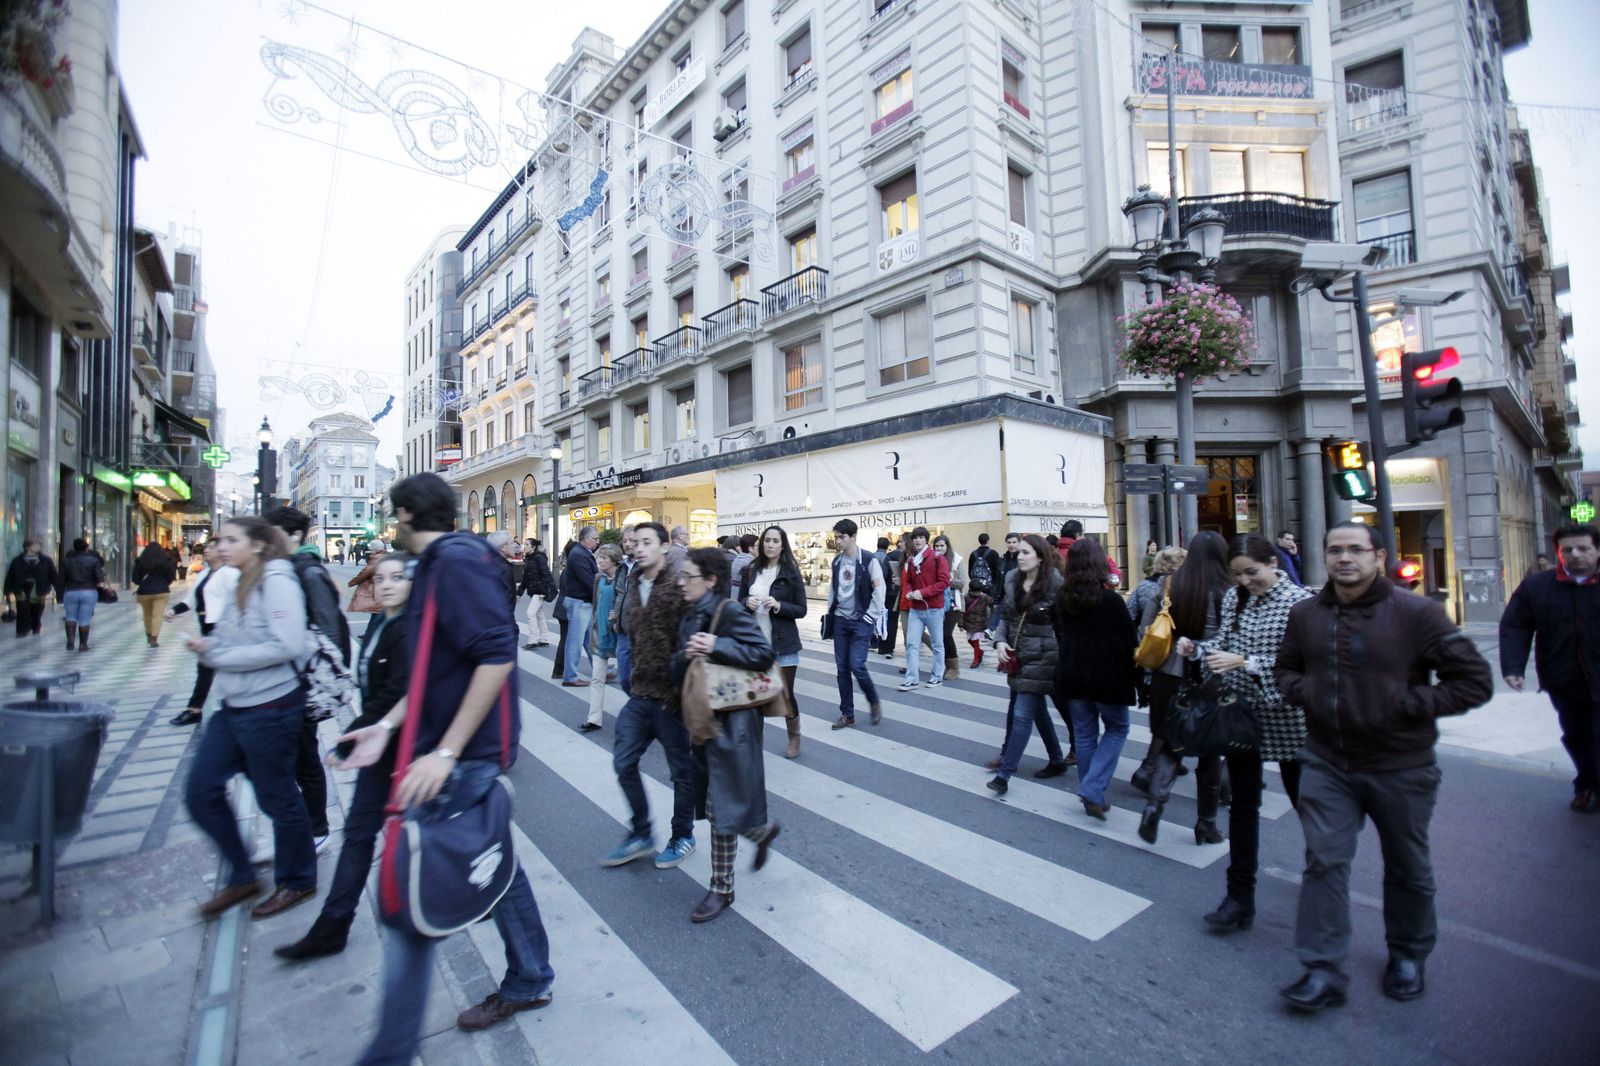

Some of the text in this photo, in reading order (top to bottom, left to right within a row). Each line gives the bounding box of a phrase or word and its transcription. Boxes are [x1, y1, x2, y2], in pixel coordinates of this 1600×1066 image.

[900, 493, 937, 502] CHAUSSURES
[943, 489, 967, 498] SCARPE
[860, 510, 928, 528] ROSSELLI
